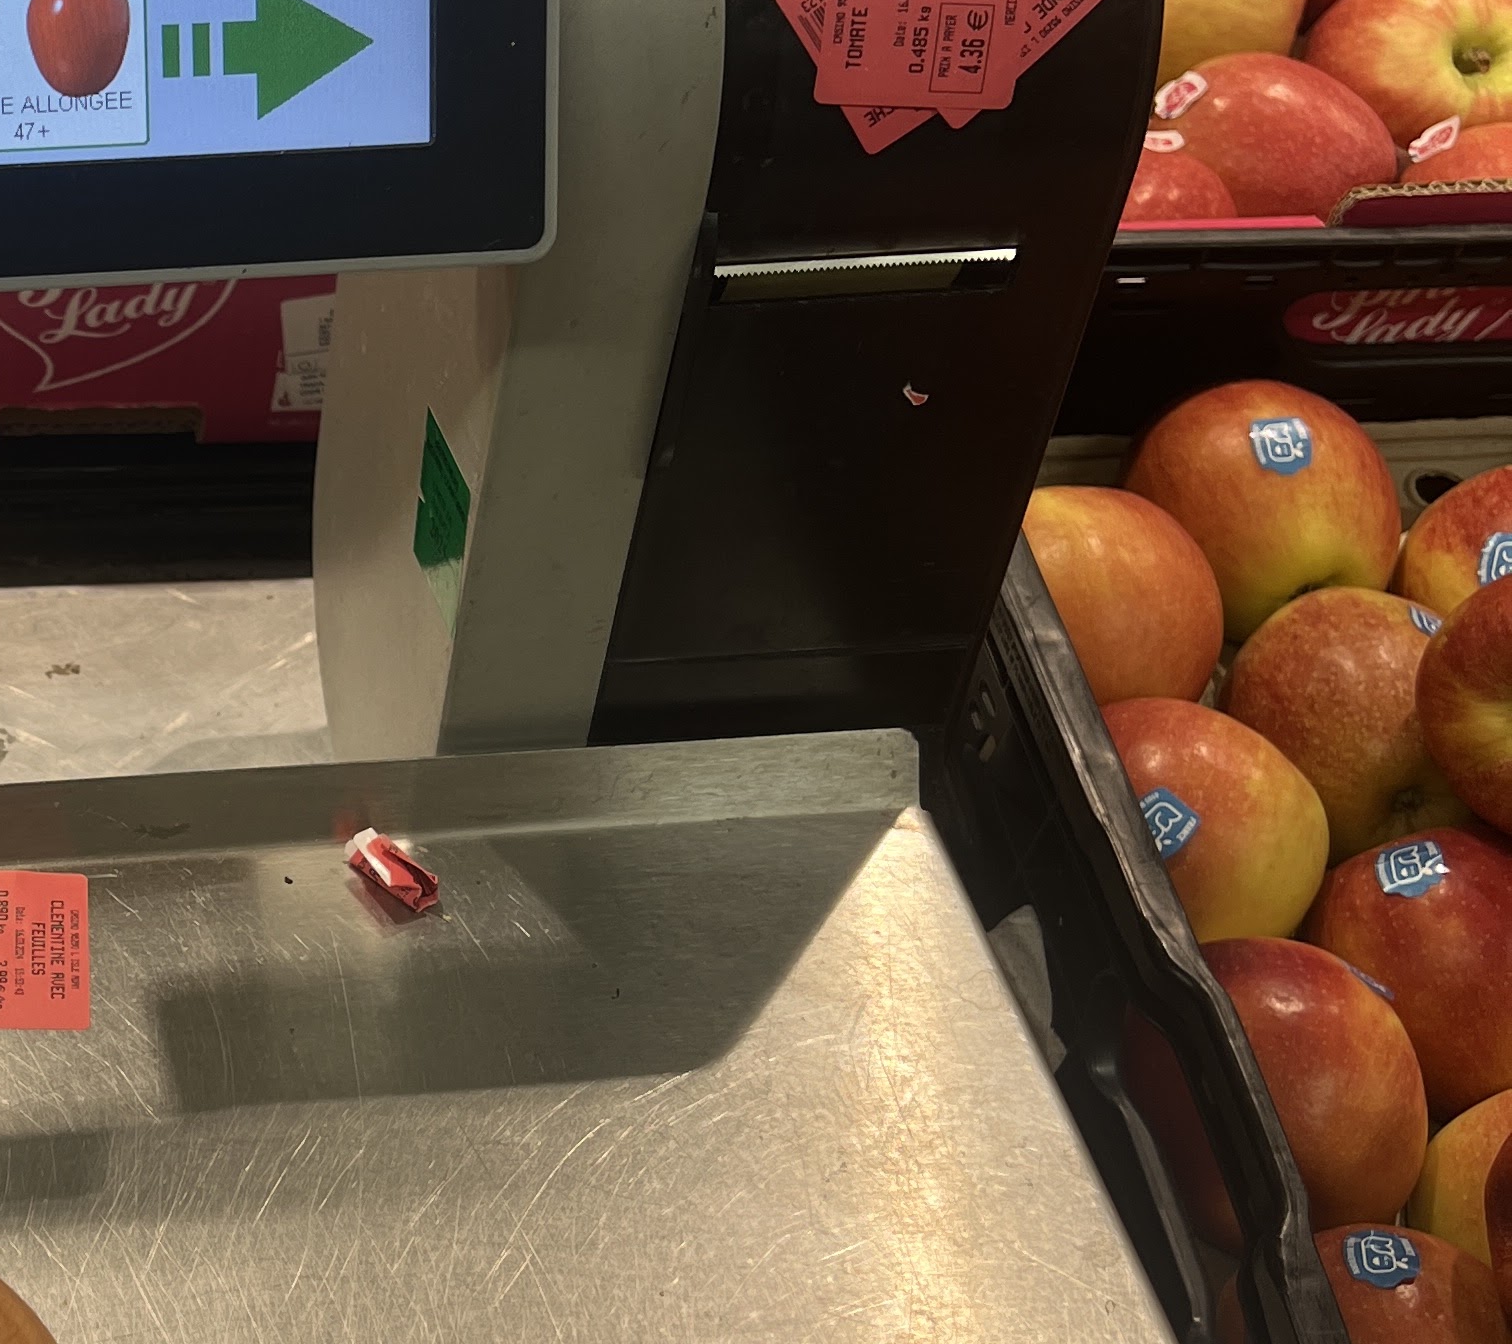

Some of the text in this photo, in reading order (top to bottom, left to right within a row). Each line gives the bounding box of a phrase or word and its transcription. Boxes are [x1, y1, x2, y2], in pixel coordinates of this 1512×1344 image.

[845, 7, 868, 69] TOMATE
[908, 6, 931, 73] 0.485 kg
[957, 9, 988, 74] 4.36 €
[13, 121, 50, 142] 47+
[21, 91, 133, 114] ALLONGEE
[39, 283, 199, 344] Lady
[31, 922, 45, 975] FEUILLES
[49, 900, 65, 999] CLEMENTINE AVEC
